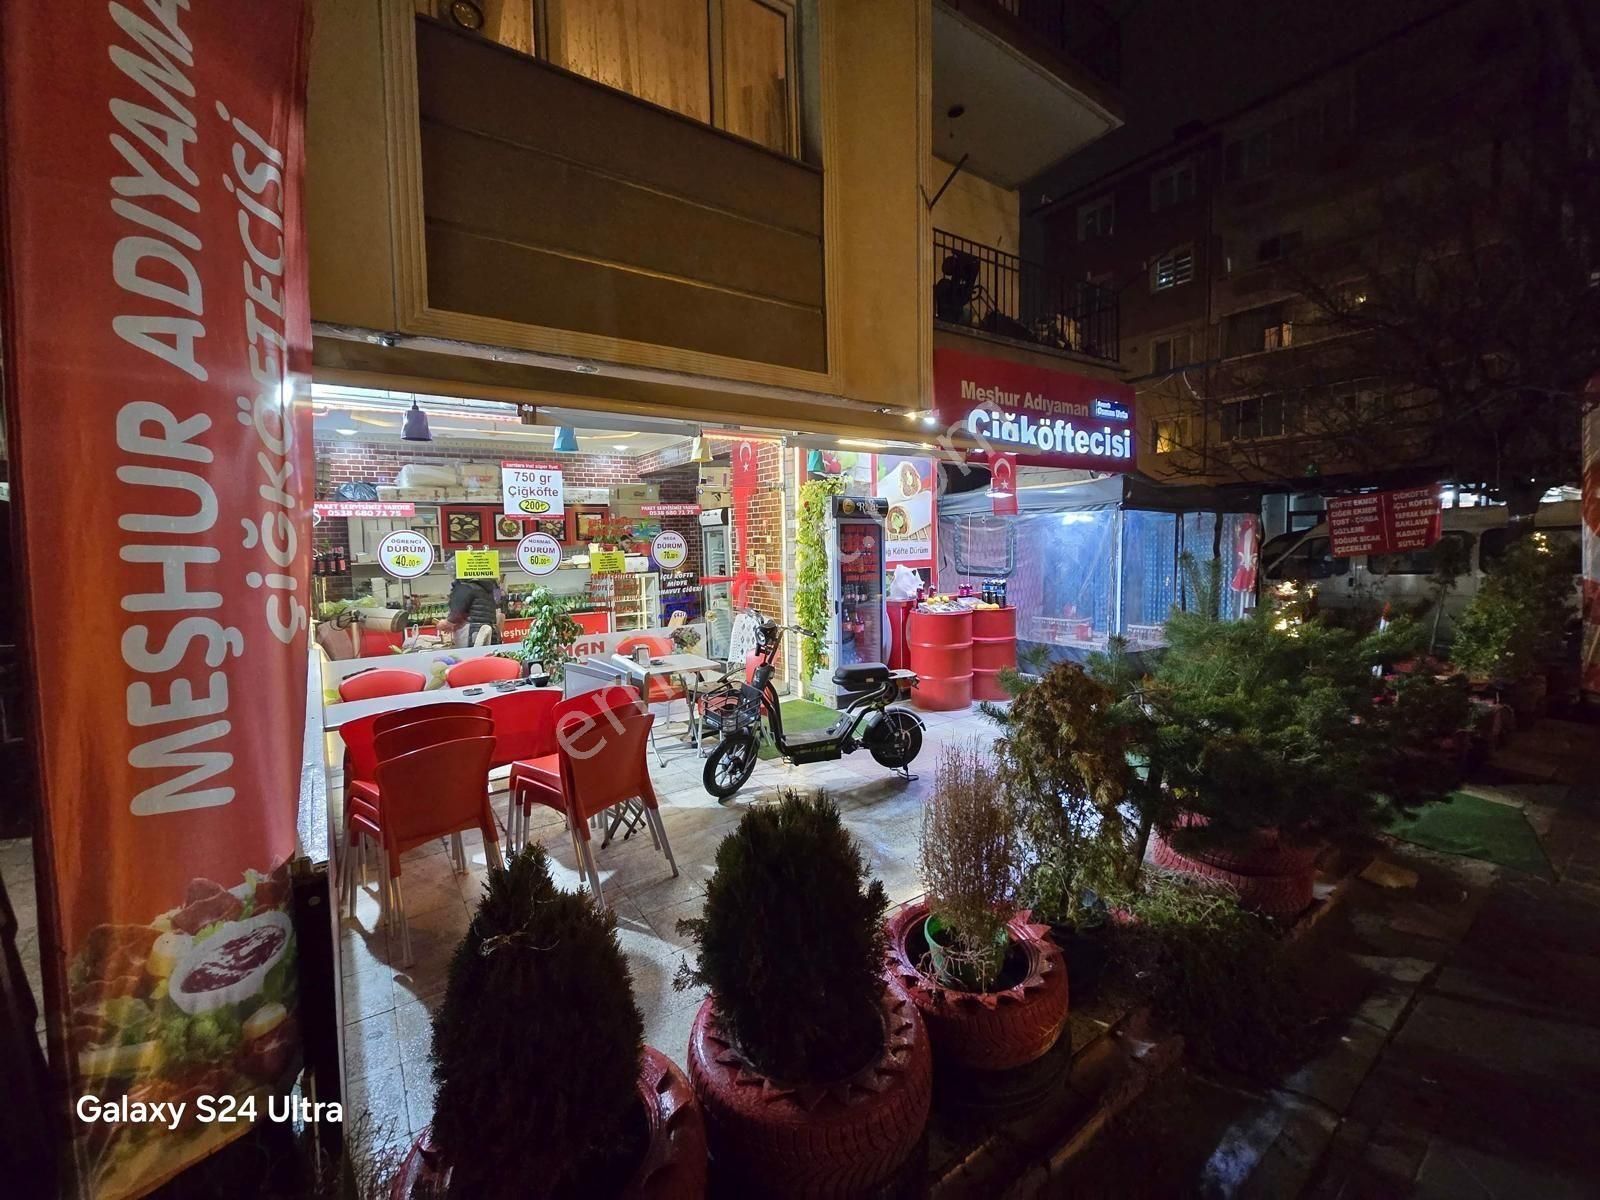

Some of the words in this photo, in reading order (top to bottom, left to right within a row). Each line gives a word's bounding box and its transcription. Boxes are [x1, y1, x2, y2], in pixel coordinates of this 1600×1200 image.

[514, 471, 535, 482] 750
[539, 474, 552, 485] gr
[508, 485, 559, 498] Çiğköfte
[386, 544, 426, 553] DÜRÜM
[523, 546, 556, 554] DÜRÜM
[116, 401, 244, 816] MEŞHUR
